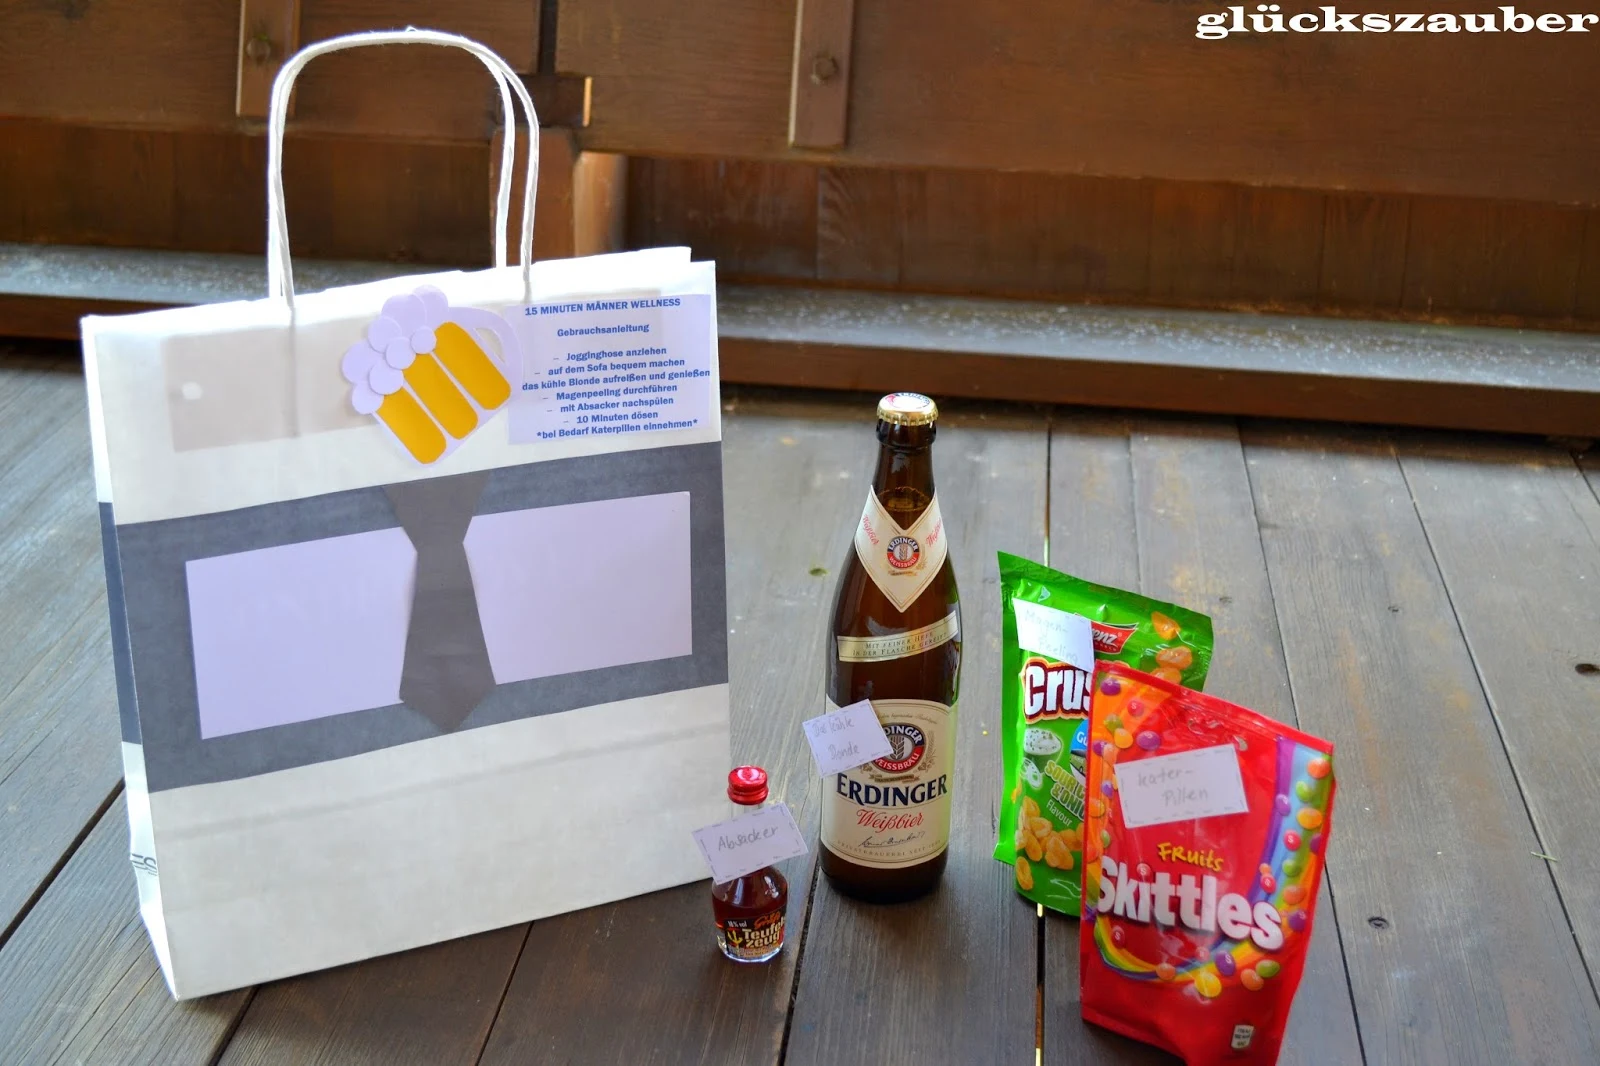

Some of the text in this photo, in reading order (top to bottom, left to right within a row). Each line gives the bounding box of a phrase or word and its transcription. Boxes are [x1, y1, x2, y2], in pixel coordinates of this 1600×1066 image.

[525, 298, 681, 316] 15 MINUTEN MÄNNER WELLNESS
[557, 324, 649, 337] Gebrauchsanleitung
[567, 348, 666, 362] Jogginghose anziehen
[548, 359, 684, 376] auf dem Sofa bequem machen
[522, 369, 710, 391] das kühle Blonde aufreißen und genießen
[557, 385, 677, 401] Magenpeeling durchführen
[560, 397, 674, 412] mit Absacker nachspülen
[591, 413, 628, 422] Minuten
[631, 411, 658, 420] dösen
[559, 427, 589, 437] Bedarf
[592, 424, 641, 435] Katerpillen
[889, 538, 918, 550] ERDINGER
[1092, 628, 1118, 648] enz
[884, 725, 922, 744] DINGER
[836, 773, 947, 806] ERDINGER
[856, 809, 924, 833] Weißbier
[1046, 799, 1072, 826] Flavour
[717, 826, 778, 851] Absacker
[1098, 855, 1283, 950] Skittles
